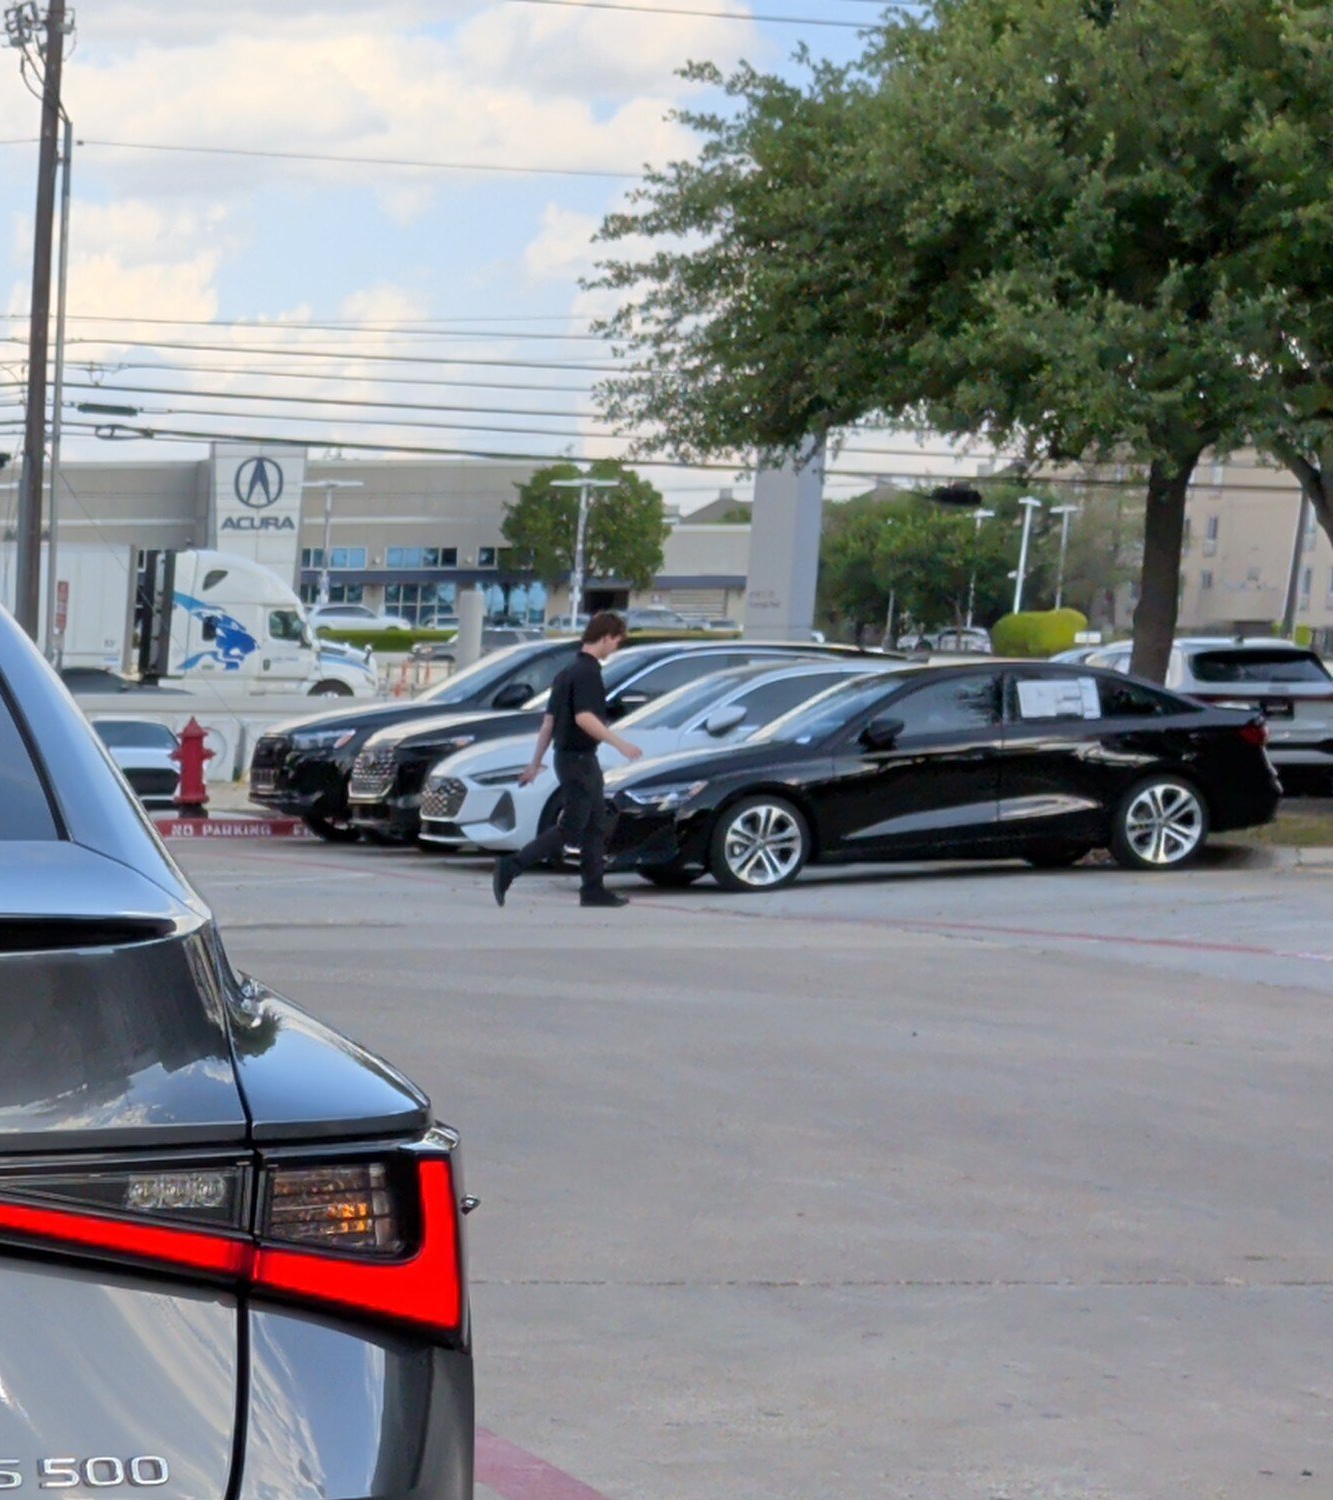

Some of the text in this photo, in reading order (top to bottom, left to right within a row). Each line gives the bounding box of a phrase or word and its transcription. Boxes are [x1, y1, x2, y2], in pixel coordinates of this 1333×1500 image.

[221, 516, 295, 530] ACURA
[171, 824, 194, 836] NO
[202, 824, 272, 837] PARKING
[38, 1455, 169, 1489] 500
